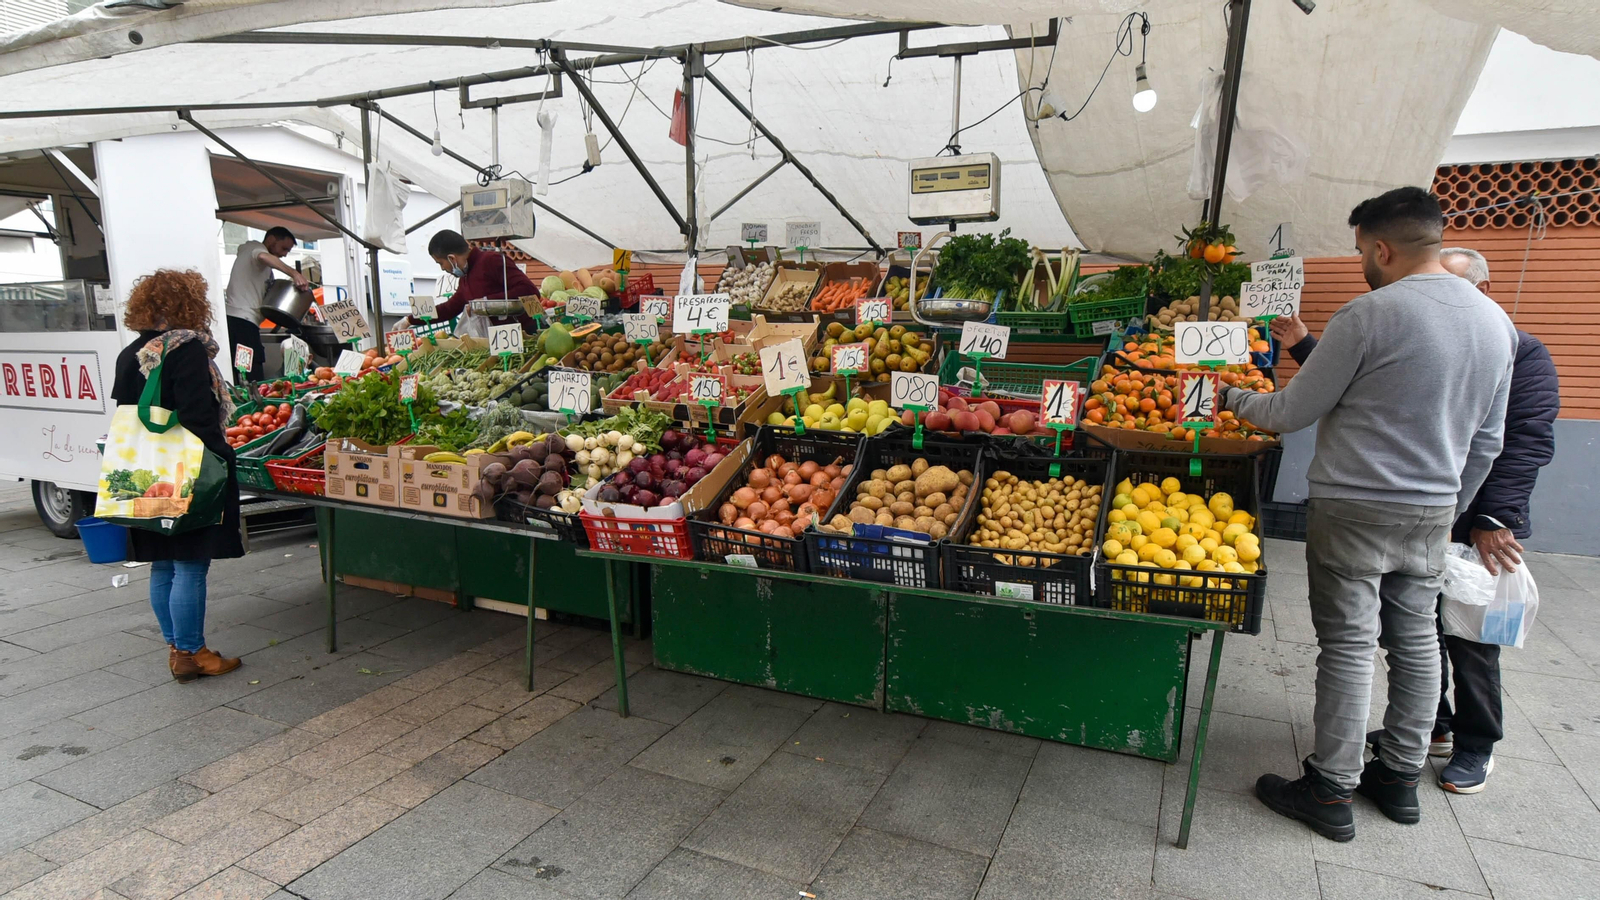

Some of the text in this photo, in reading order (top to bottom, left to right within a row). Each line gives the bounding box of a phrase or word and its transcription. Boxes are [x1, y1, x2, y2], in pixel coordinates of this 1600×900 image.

[1256, 261, 1290, 272] ESPECIAL
[1243, 282, 1300, 293] TESORILLO
[323, 299, 355, 314] TOMATE
[568, 295, 599, 306] PAPAYA
[1246, 292, 1295, 308] 2 KILOS
[328, 309, 360, 324] HUERTO
[624, 321, 657, 340] 2'50
[1181, 324, 1247, 357] 0'80
[549, 372, 589, 386] CANARIO
[895, 376, 938, 403] 0'80
[553, 385, 590, 413] 1'50
[349, 455, 373, 463] MANOJOS
[426, 463, 452, 471] MANOJOS
